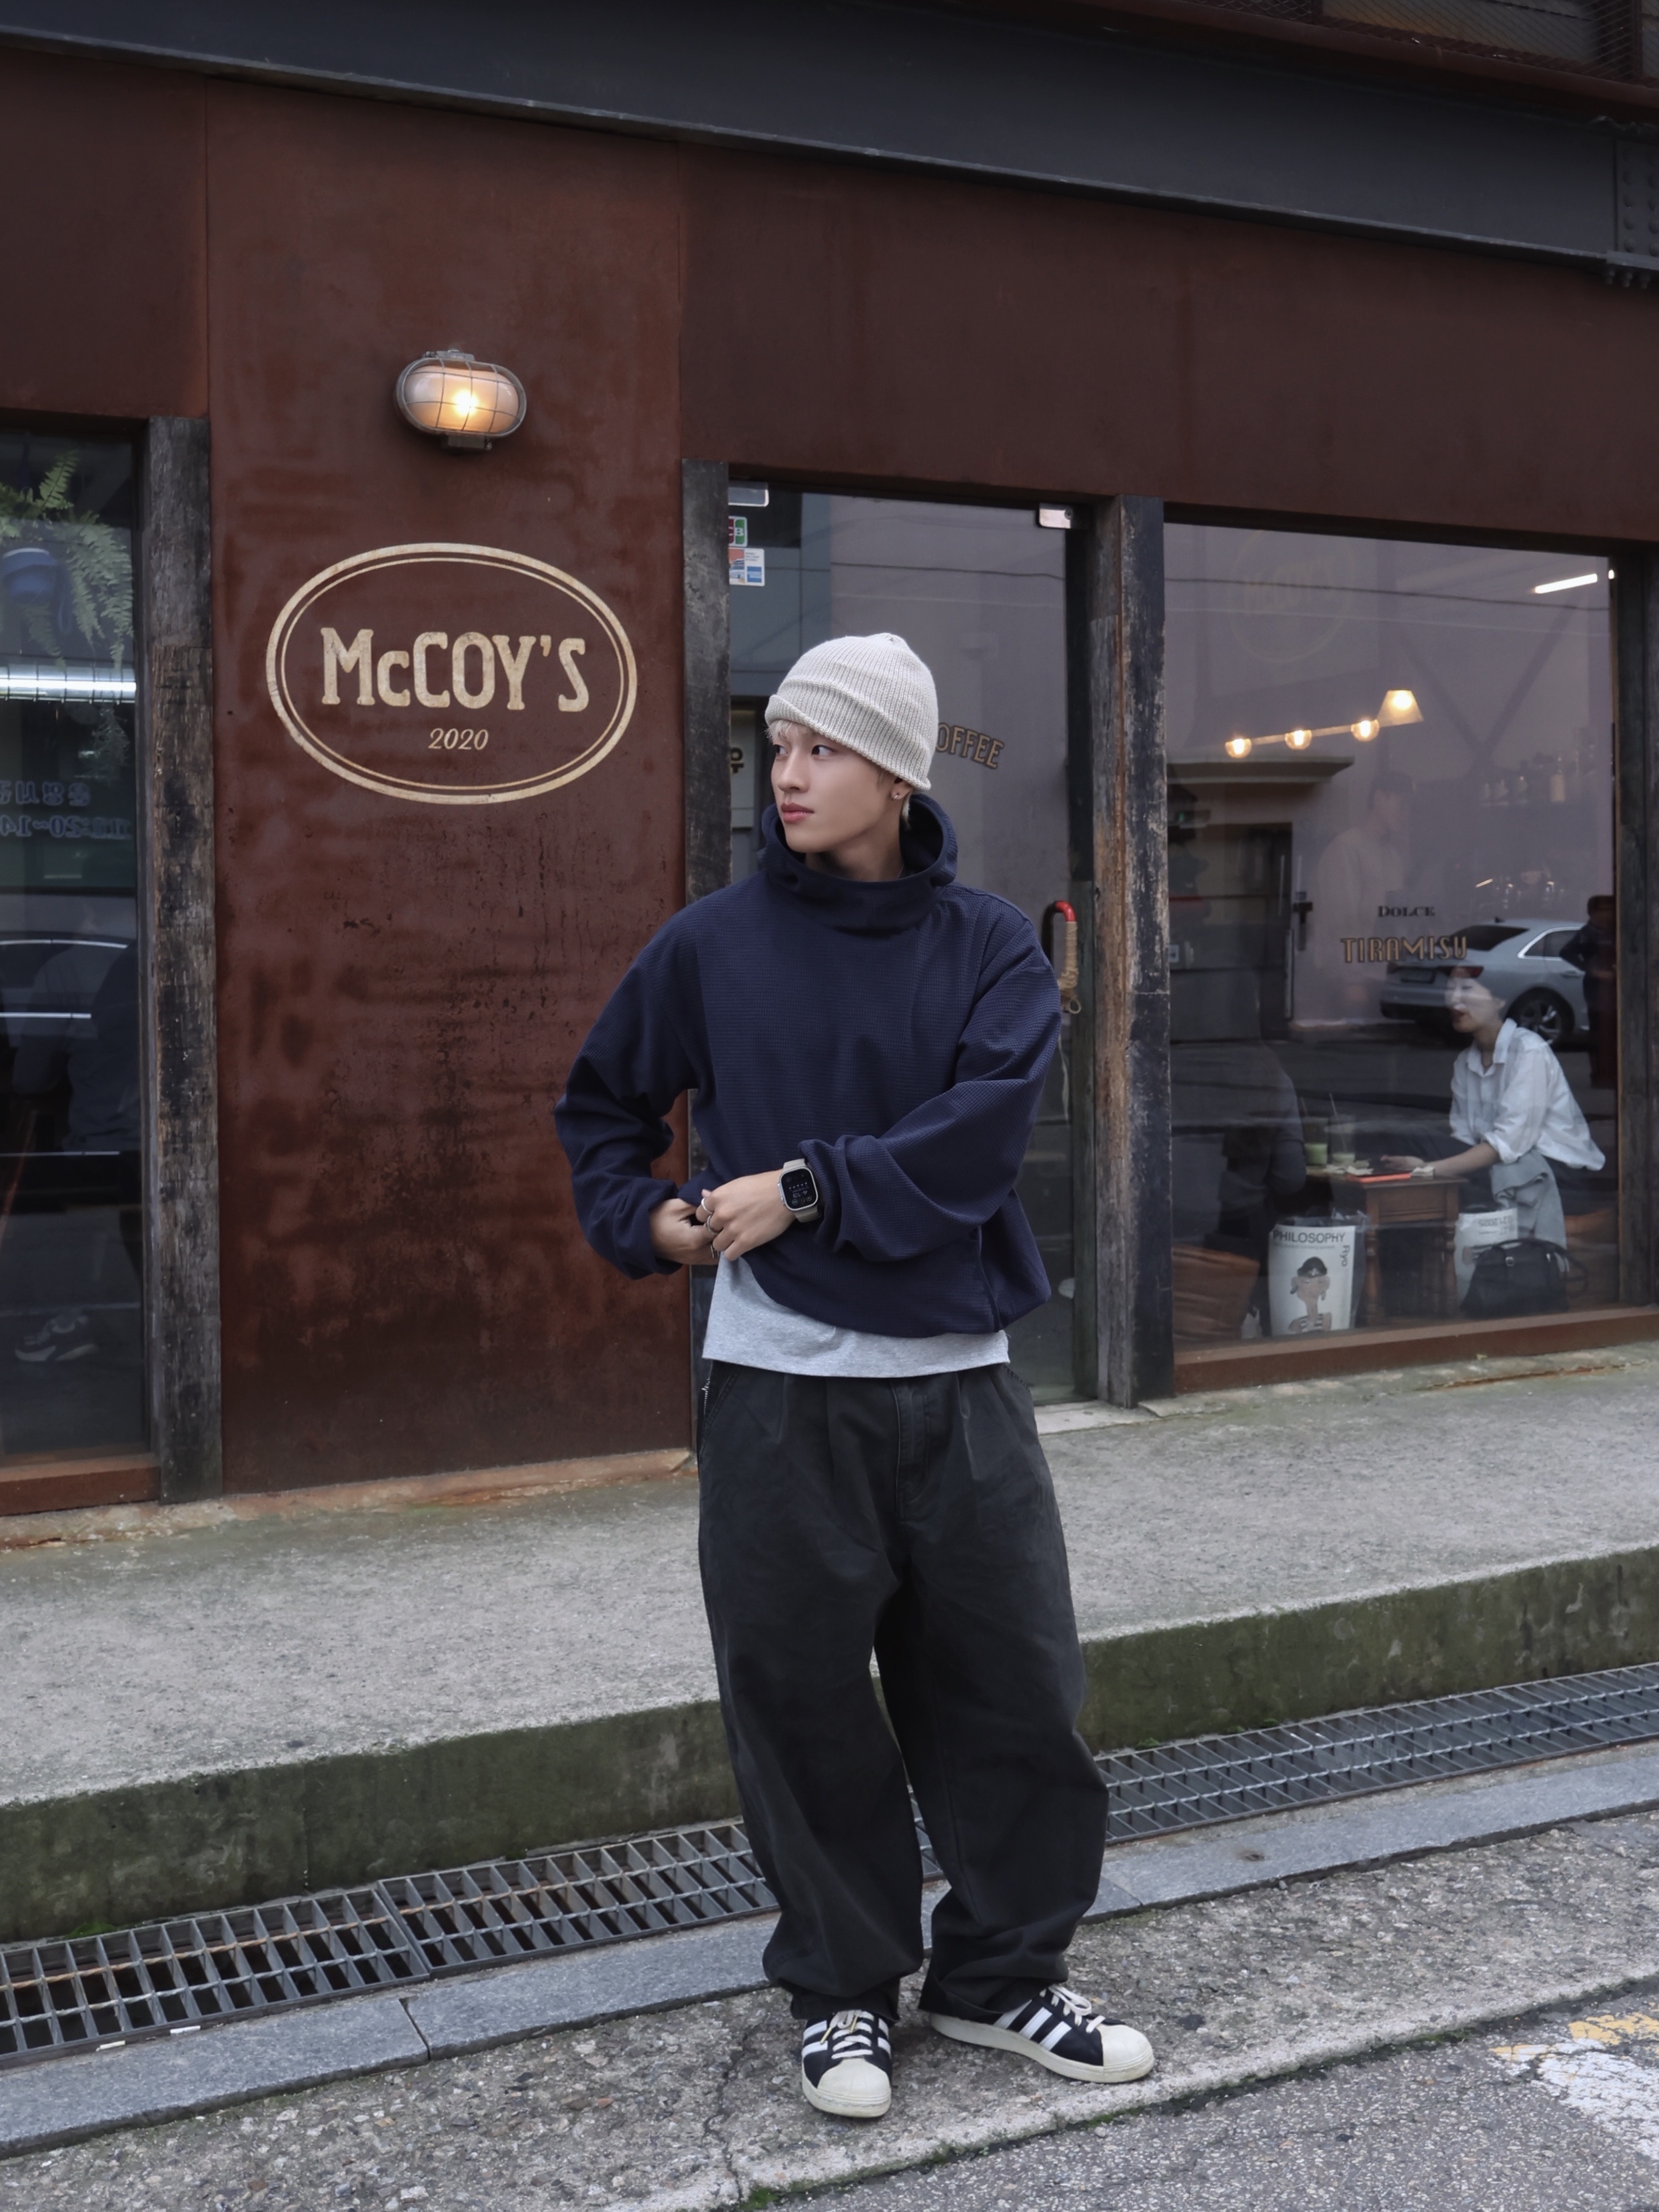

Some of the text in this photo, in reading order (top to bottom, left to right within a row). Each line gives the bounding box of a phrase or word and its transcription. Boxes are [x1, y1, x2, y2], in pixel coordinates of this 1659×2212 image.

[321, 627, 589, 712] McCOY'S
[428, 728, 489, 751] 2020
[936, 722, 1004, 769] OFFEE
[1378, 905, 1435, 917] DOLCE
[1340, 936, 1467, 963] TIRAMISU
[1272, 1230, 1346, 1243] PHILOSOPHY
[1340, 1245, 1350, 1267] Ryo
